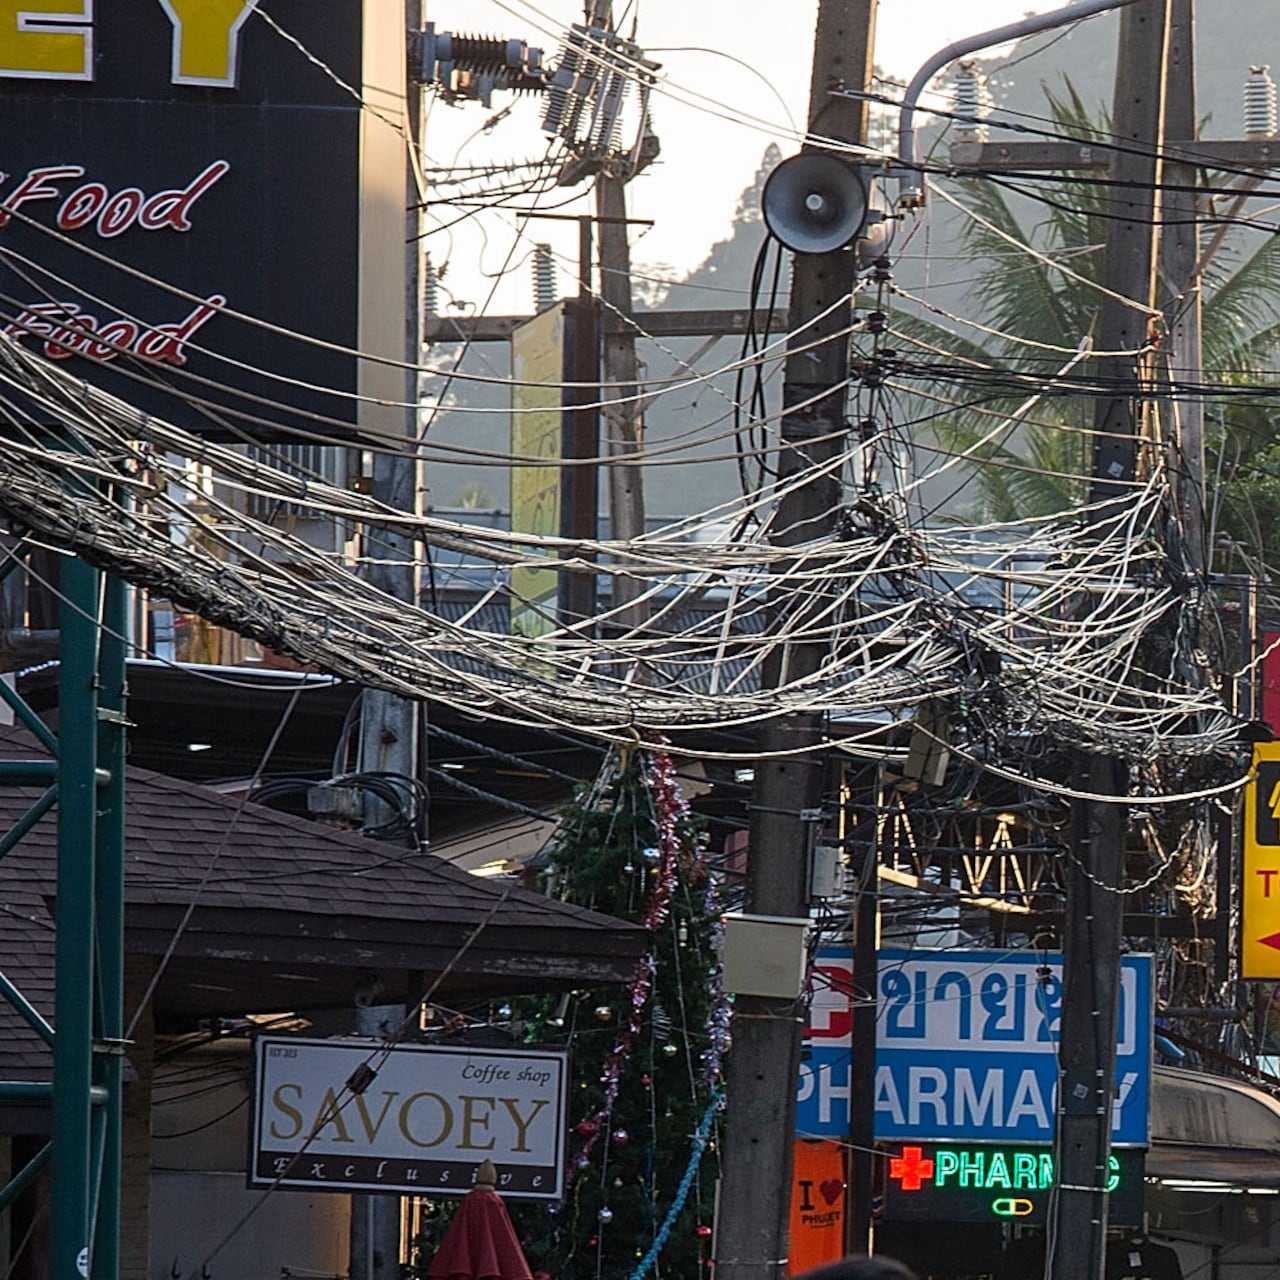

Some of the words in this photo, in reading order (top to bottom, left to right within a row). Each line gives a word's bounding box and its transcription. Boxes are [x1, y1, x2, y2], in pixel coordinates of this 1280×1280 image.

[3, 160, 230, 238] Food
[3, 294, 227, 367] Food
[881, 969, 1126, 1043] ขายย
[462, 1064, 510, 1084] Coffee
[516, 1066, 551, 1087] shop
[269, 1083, 549, 1153] SAVOEY
